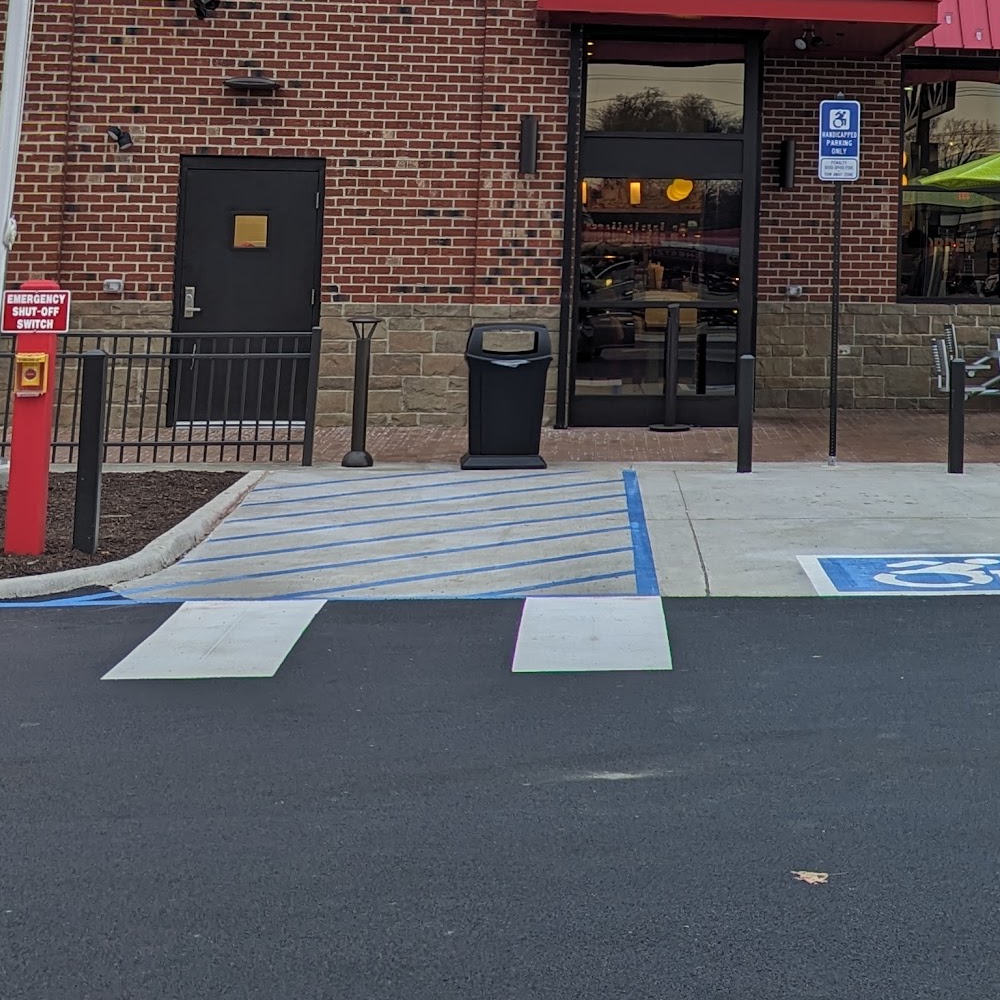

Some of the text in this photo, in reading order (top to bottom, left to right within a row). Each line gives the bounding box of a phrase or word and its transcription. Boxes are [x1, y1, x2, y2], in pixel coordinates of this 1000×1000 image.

[7, 294, 66, 304] EMERGENCY
[12, 306, 60, 316] SHUT-OFF
[16, 319, 54, 329] SWITCH
